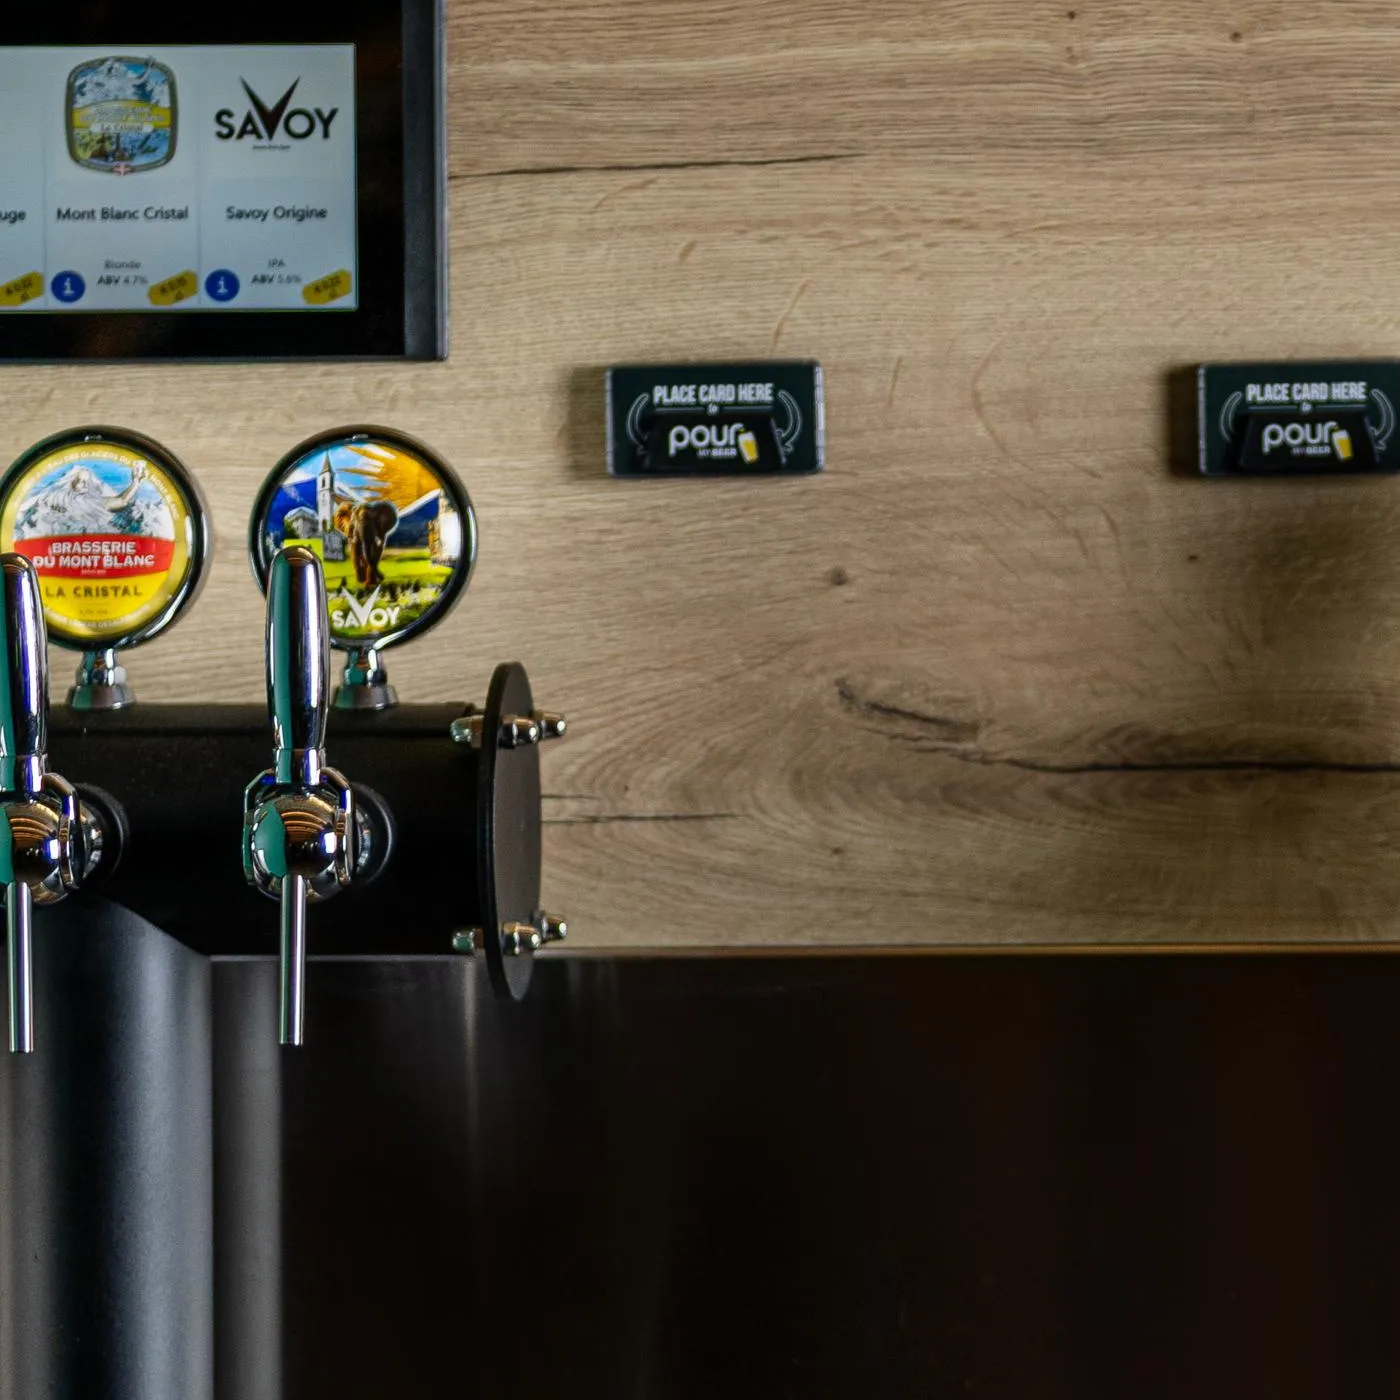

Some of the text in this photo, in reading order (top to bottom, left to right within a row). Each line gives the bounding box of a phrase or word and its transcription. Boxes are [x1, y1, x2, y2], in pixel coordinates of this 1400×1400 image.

[214, 75, 339, 141] SAVOY
[56, 206, 189, 220] Mont Blanc Cristal
[226, 206, 328, 222] Savoy Origine
[97, 275, 121, 286] ABV
[251, 274, 275, 285] ABV
[653, 382, 775, 405] PLACE CARD HERE
[1246, 381, 1368, 403] PLACE CARD HERE
[668, 422, 745, 457] pour
[1262, 420, 1338, 454] pour
[711, 448, 737, 457] BEER
[50, 541, 137, 555] BRASSERIE
[31, 554, 156, 568] DU MONT BLANC
[45, 585, 143, 598] LA CRISTAL
[330, 584, 400, 629] SAVOY
